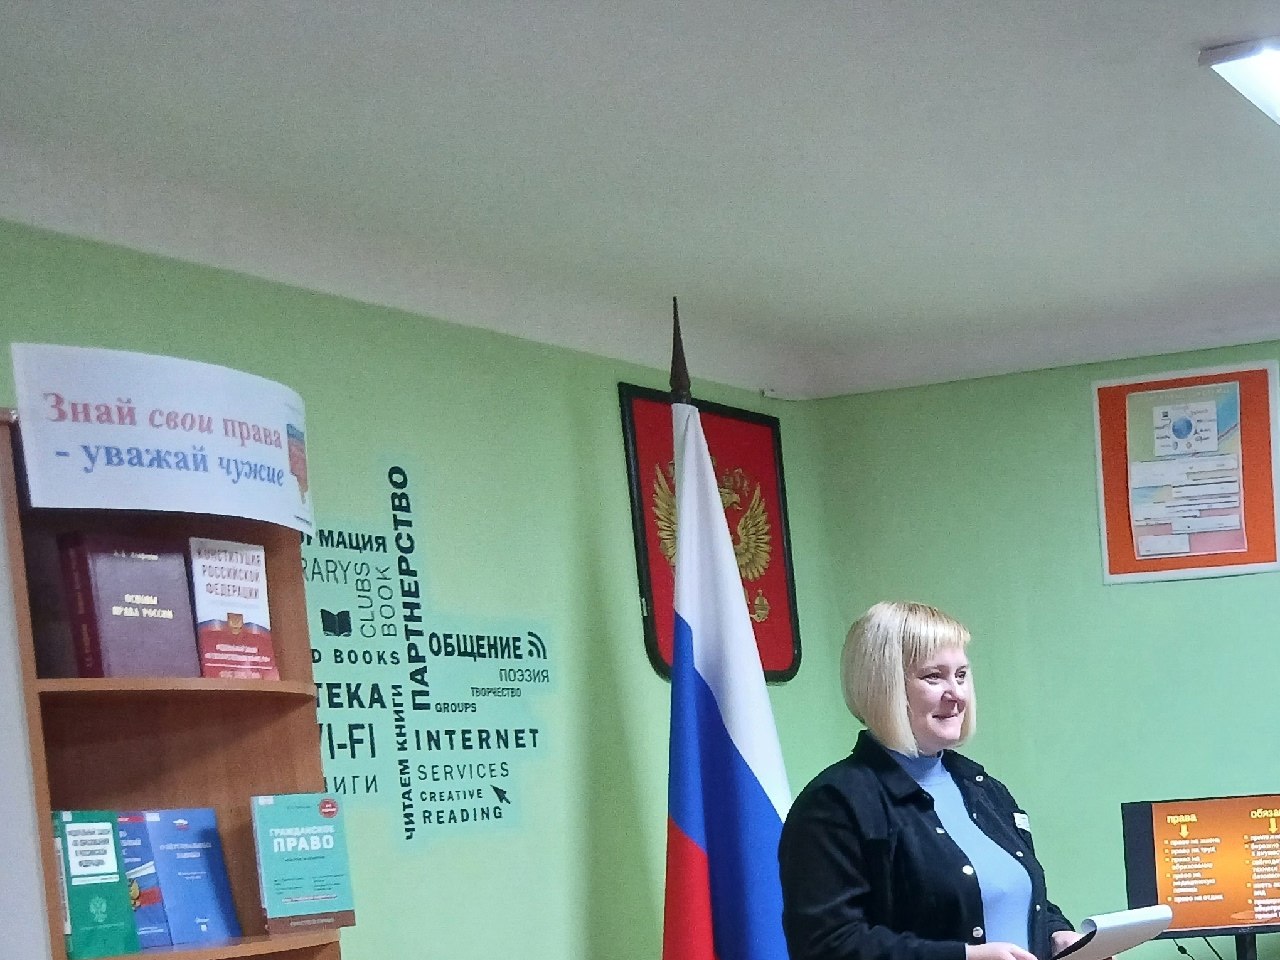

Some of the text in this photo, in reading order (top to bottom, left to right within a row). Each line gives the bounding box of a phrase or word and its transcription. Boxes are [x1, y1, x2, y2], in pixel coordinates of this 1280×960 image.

[43, 392, 283, 449] Знай свои права
[80, 444, 209, 474] уважай
[217, 456, 285, 487] чужие
[388, 466, 431, 711] ПАРТНЕРСТВО
[354, 562, 377, 638] CLUBS
[375, 566, 397, 637] BOOK
[333, 648, 401, 665] BOOKS
[428, 632, 523, 662] ОБЩЕНИЕ
[500, 668, 550, 683] ПОЭЗИЯ
[471, 686, 522, 698] ТВОРЧЕСТВО
[435, 702, 477, 713] GROUPS
[415, 728, 539, 751] INTERNET
[391, 684, 416, 841] ЧИТАЕМ КНИГИ
[418, 761, 510, 782] SERVICES
[420, 788, 484, 802] CREATIVE
[423, 806, 503, 825] READING
[273, 834, 335, 853] ПРАВО
